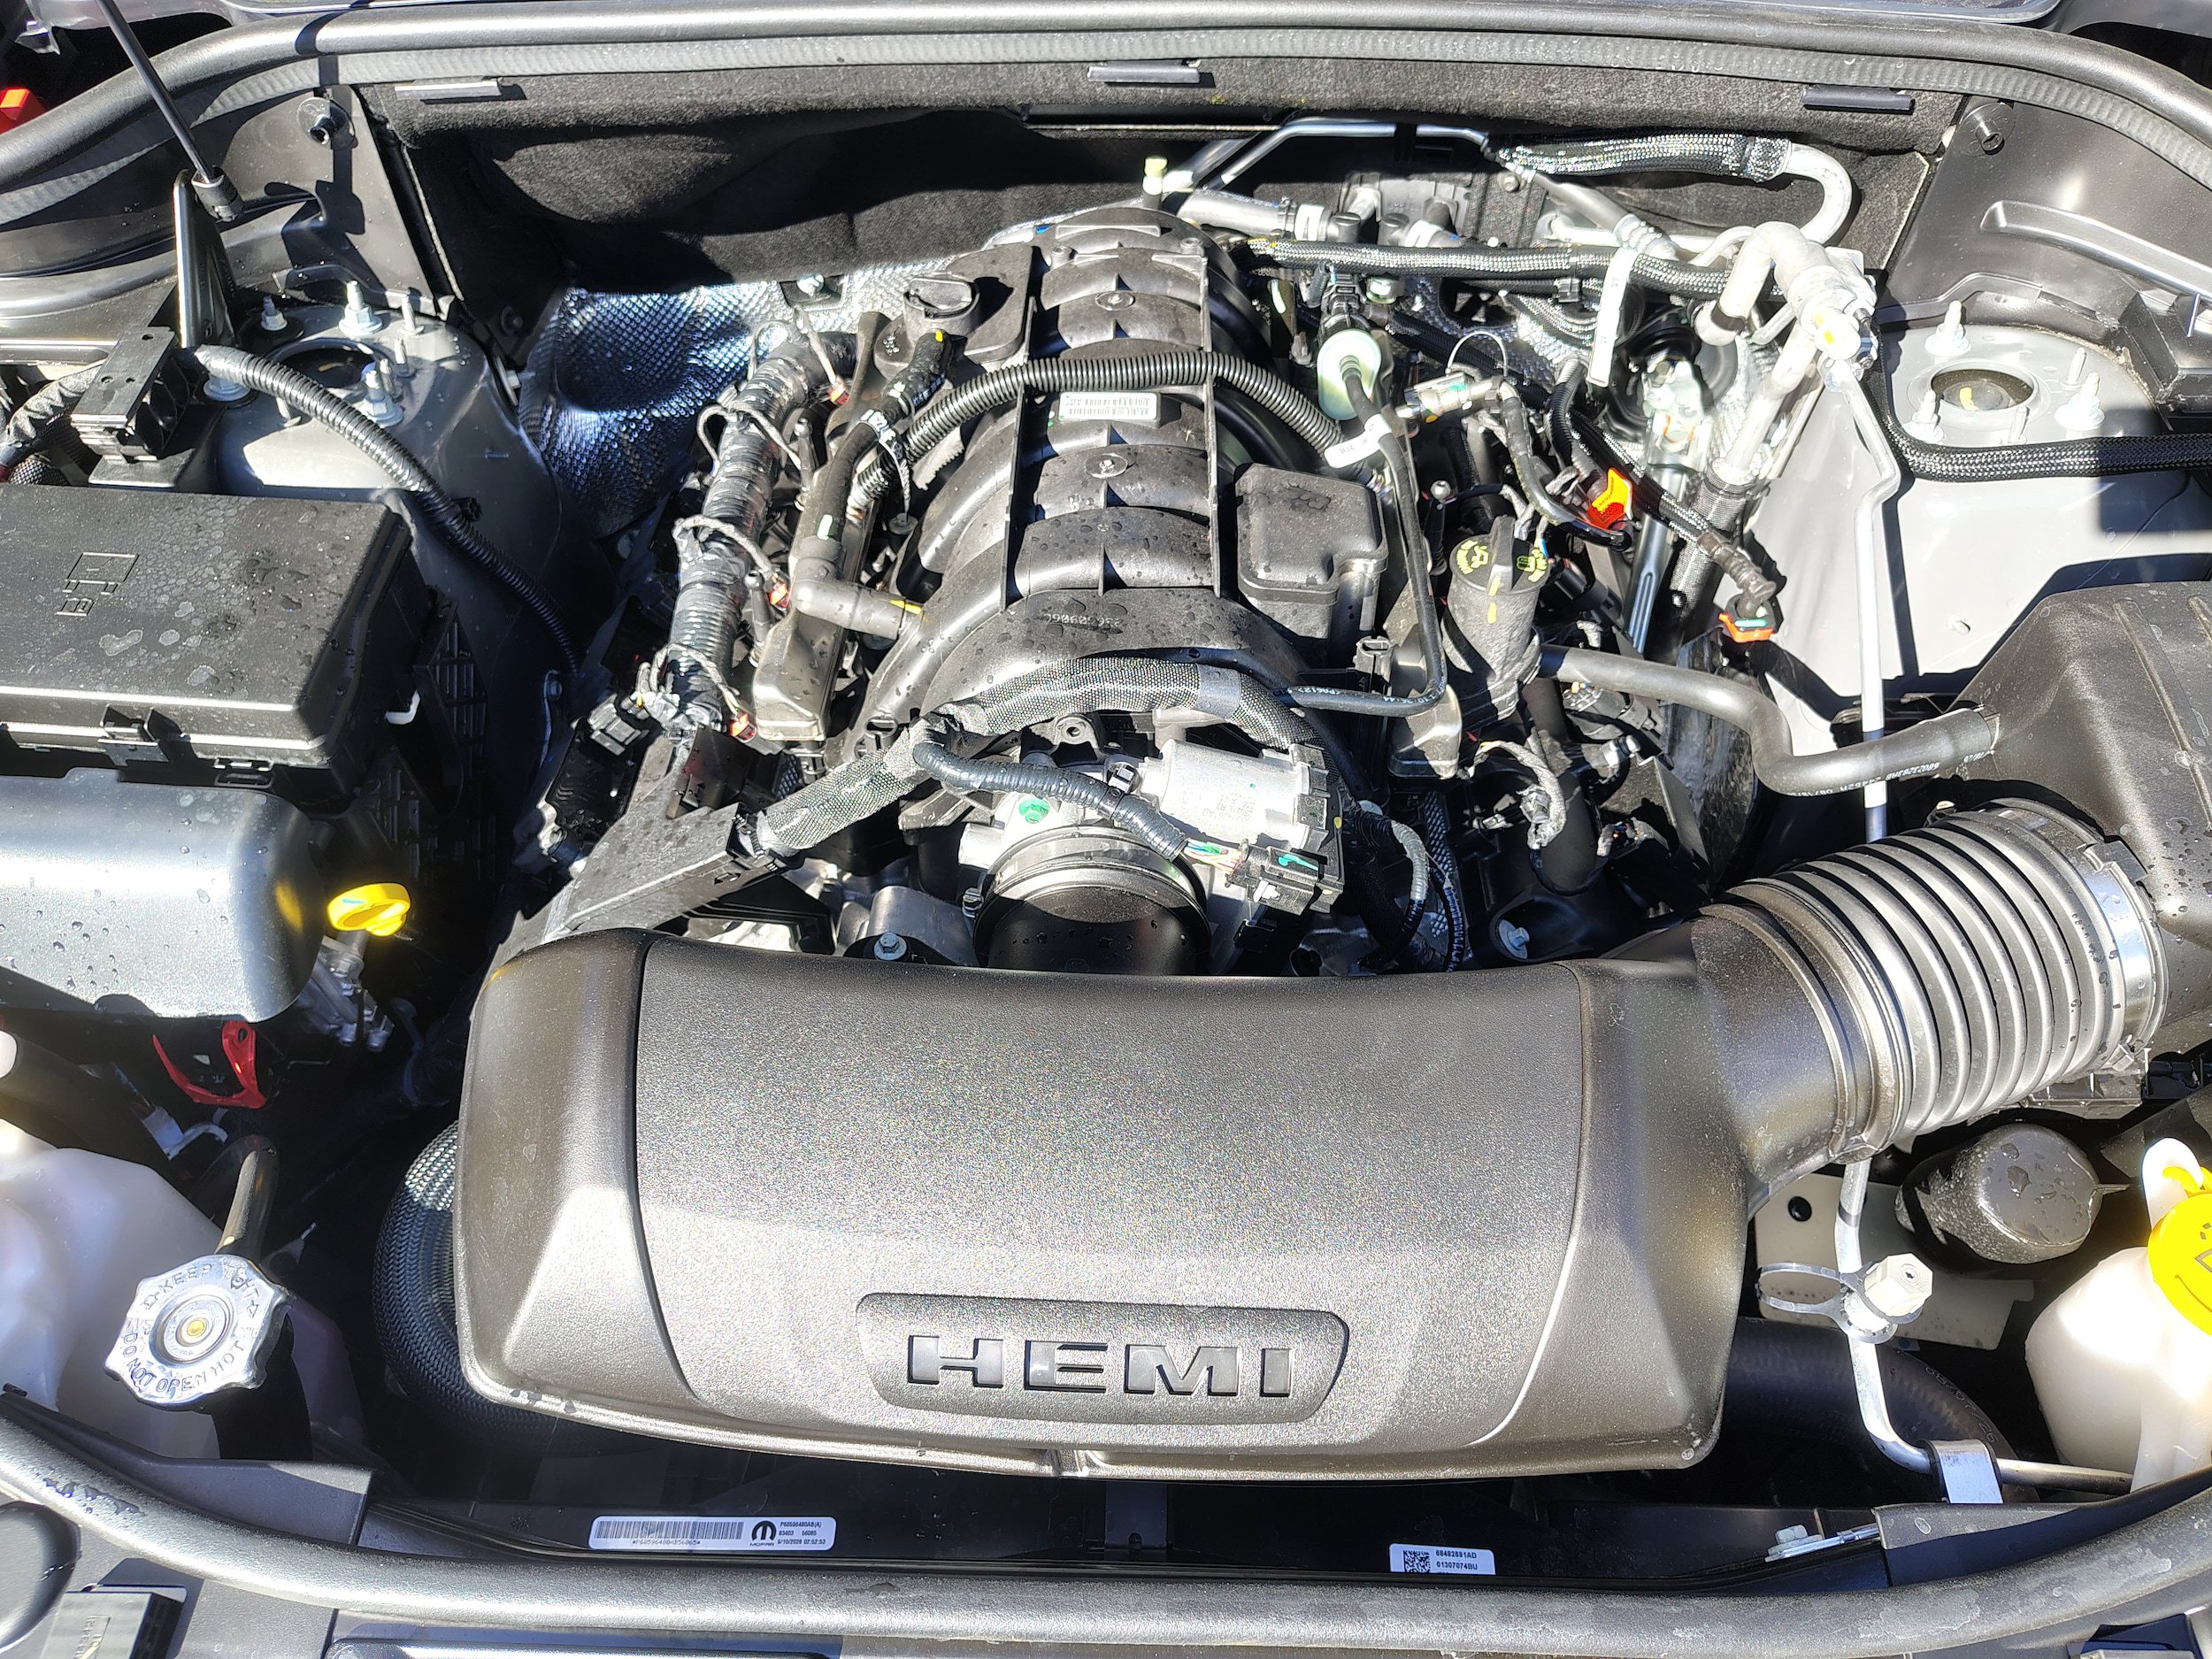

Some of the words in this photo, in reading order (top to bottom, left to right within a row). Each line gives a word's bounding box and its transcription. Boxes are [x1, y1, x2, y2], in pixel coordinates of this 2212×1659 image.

[162, 1263, 213, 1294] KEEP
[211, 1340, 245, 1377] HOT
[907, 1334, 1294, 1398] HEMI
